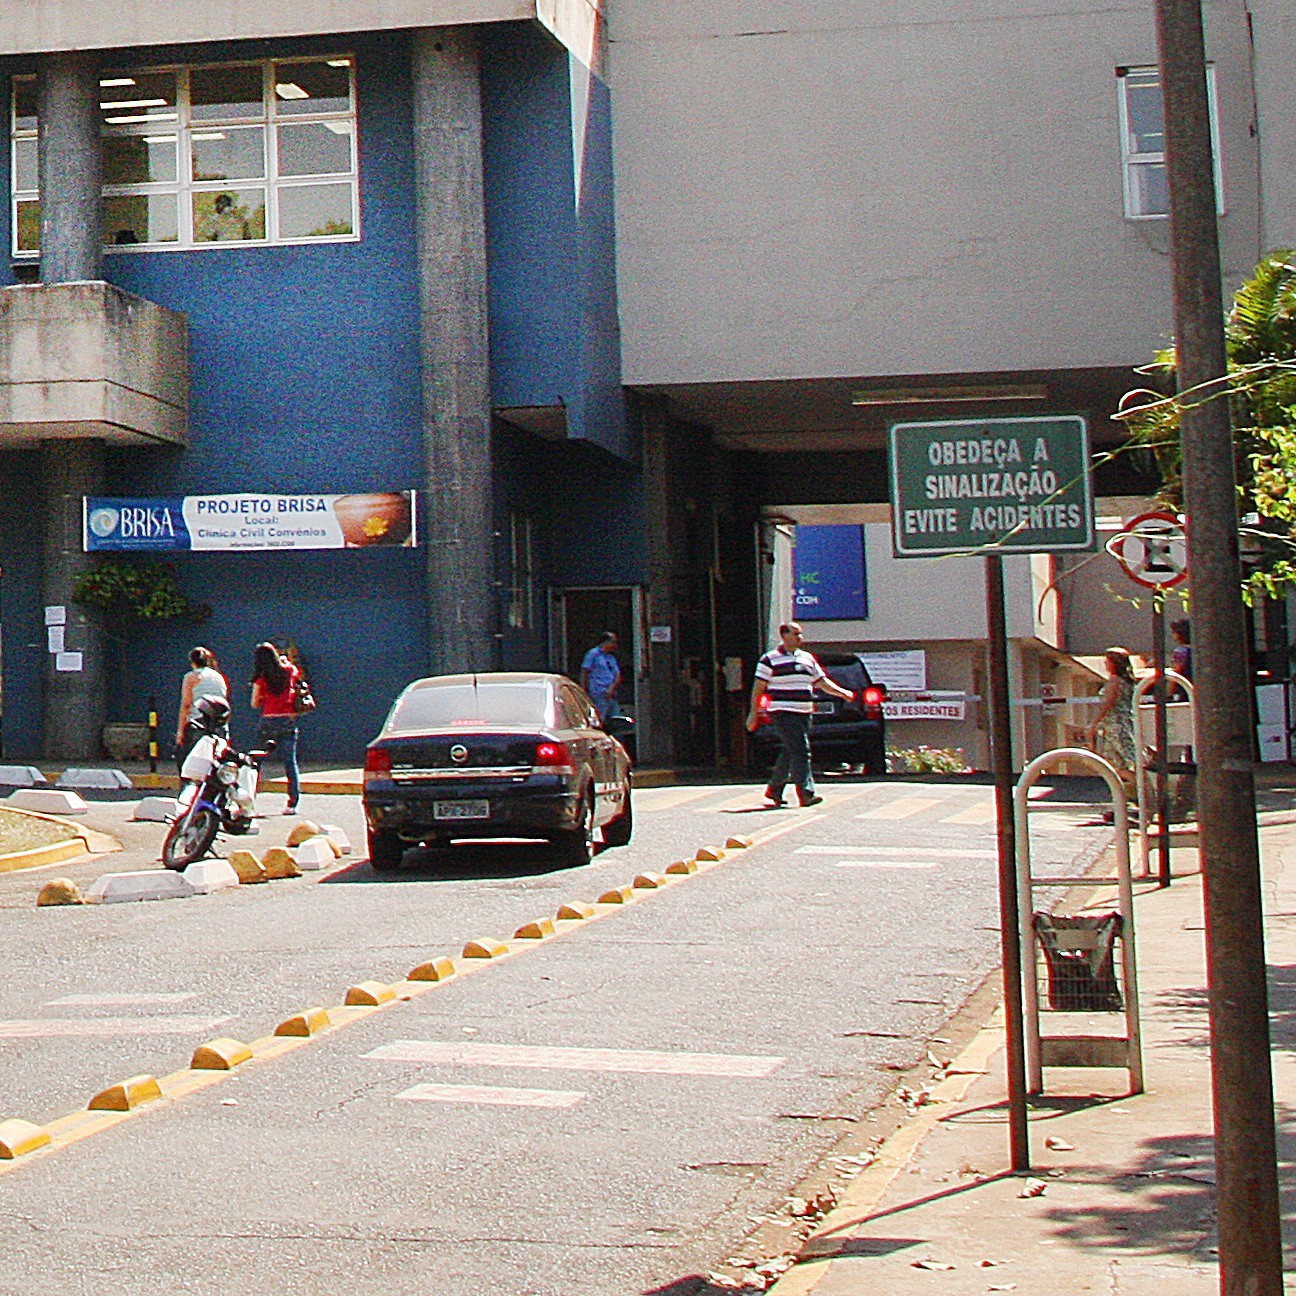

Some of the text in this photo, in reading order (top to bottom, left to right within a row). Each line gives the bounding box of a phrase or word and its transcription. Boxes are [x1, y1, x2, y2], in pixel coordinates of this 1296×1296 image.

[927, 437, 1049, 469] OBEDEÇA A
[924, 464, 1057, 503] SINALIZAÇÃO
[197, 498, 328, 514] PROJETO BRISA
[244, 516, 279, 525] Local:
[904, 503, 1081, 534] EVITE ACIDENTES
[121, 507, 175, 537] BRISA
[901, 705, 960, 717] RESIDENTES
